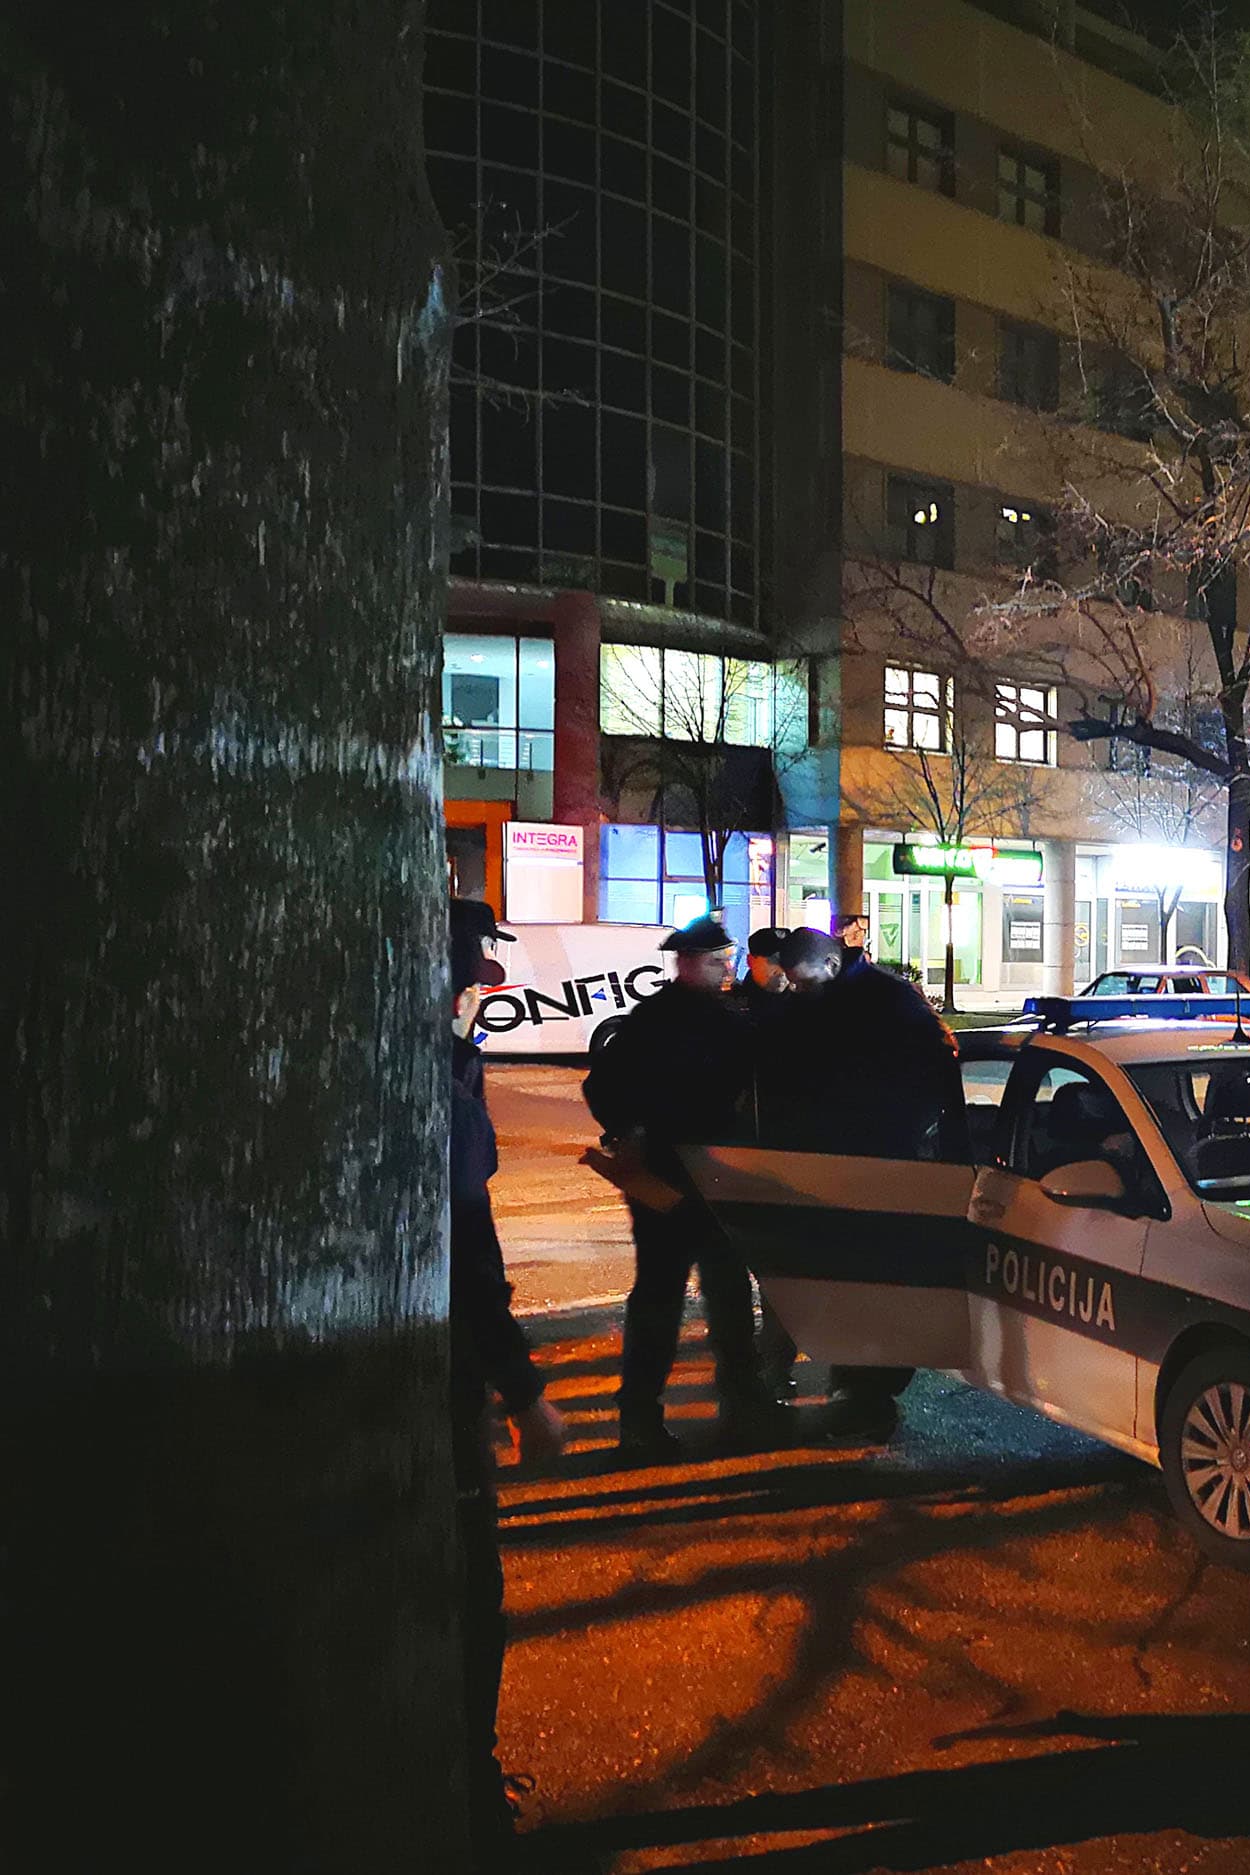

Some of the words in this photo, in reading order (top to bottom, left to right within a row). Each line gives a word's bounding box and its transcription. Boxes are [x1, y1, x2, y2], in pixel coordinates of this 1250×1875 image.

[512, 831, 578, 847] INTEGRA
[475, 965, 671, 1033] ONFIG
[986, 1243, 1116, 1331] POLICIJA
